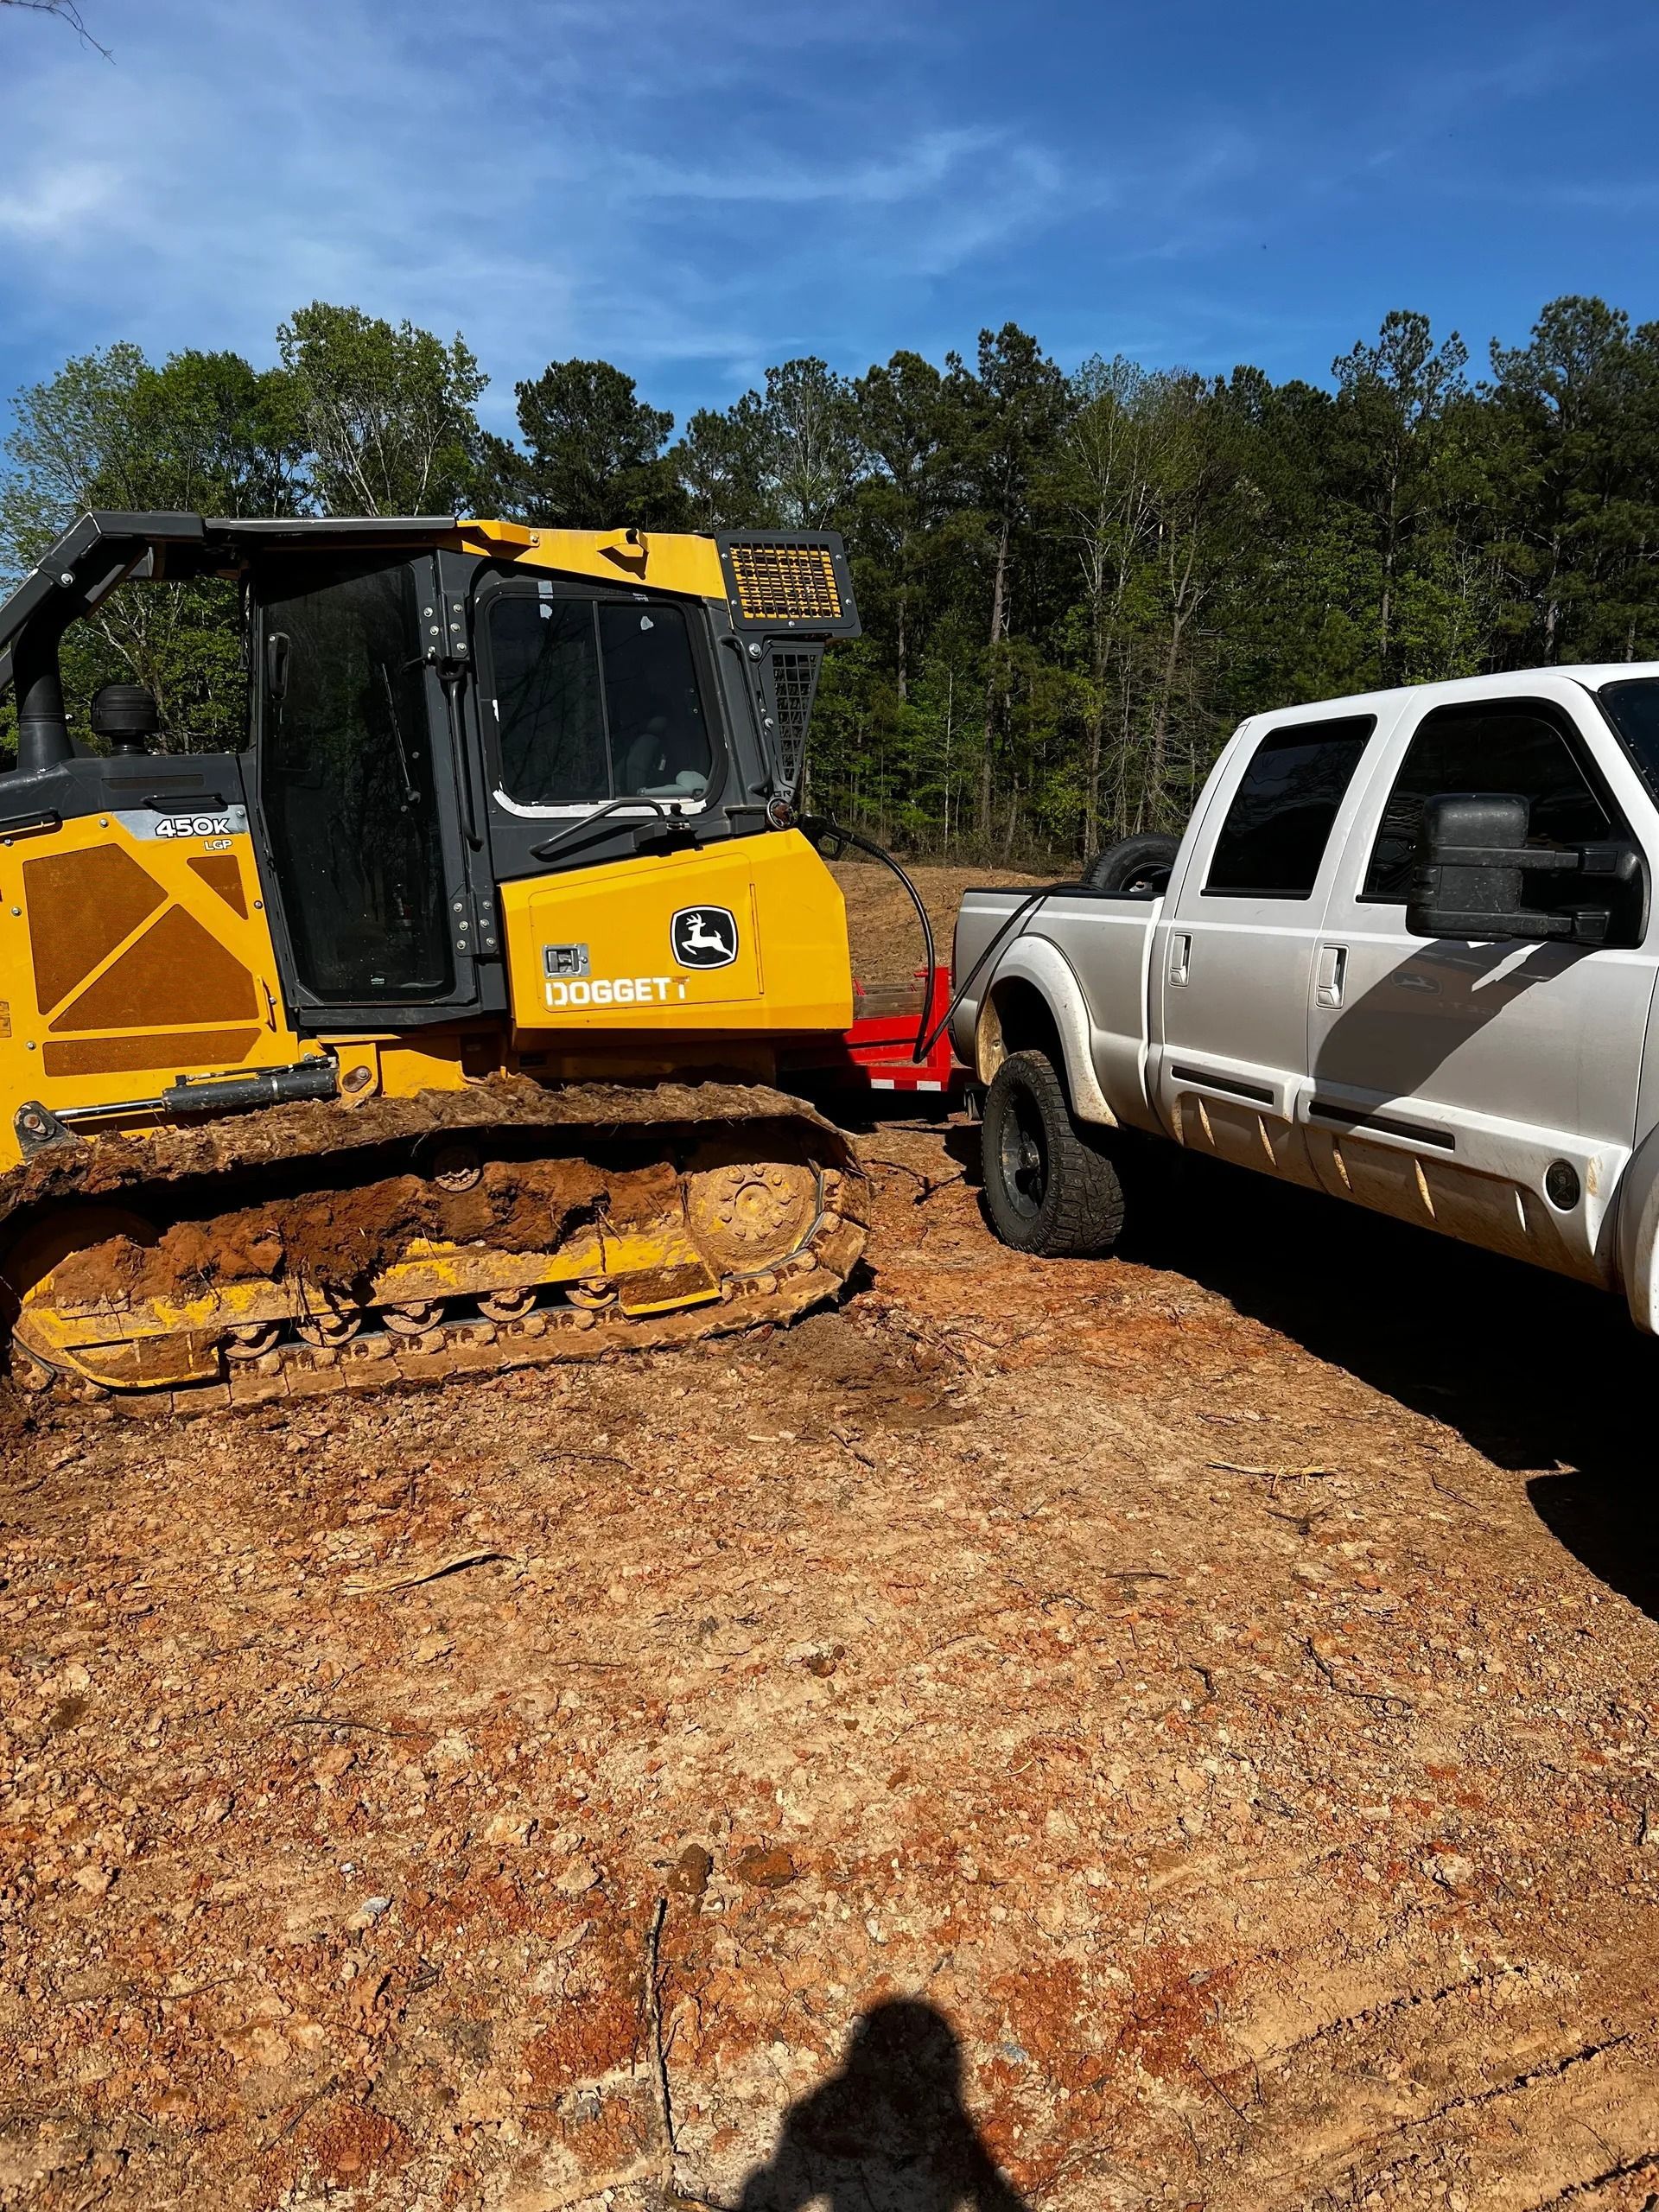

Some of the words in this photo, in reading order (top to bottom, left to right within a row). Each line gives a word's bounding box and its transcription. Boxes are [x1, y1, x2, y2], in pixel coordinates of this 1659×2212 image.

[155, 817, 230, 837] 450K
[204, 839, 232, 851] LGP
[545, 976, 690, 1006] DOGGETT
